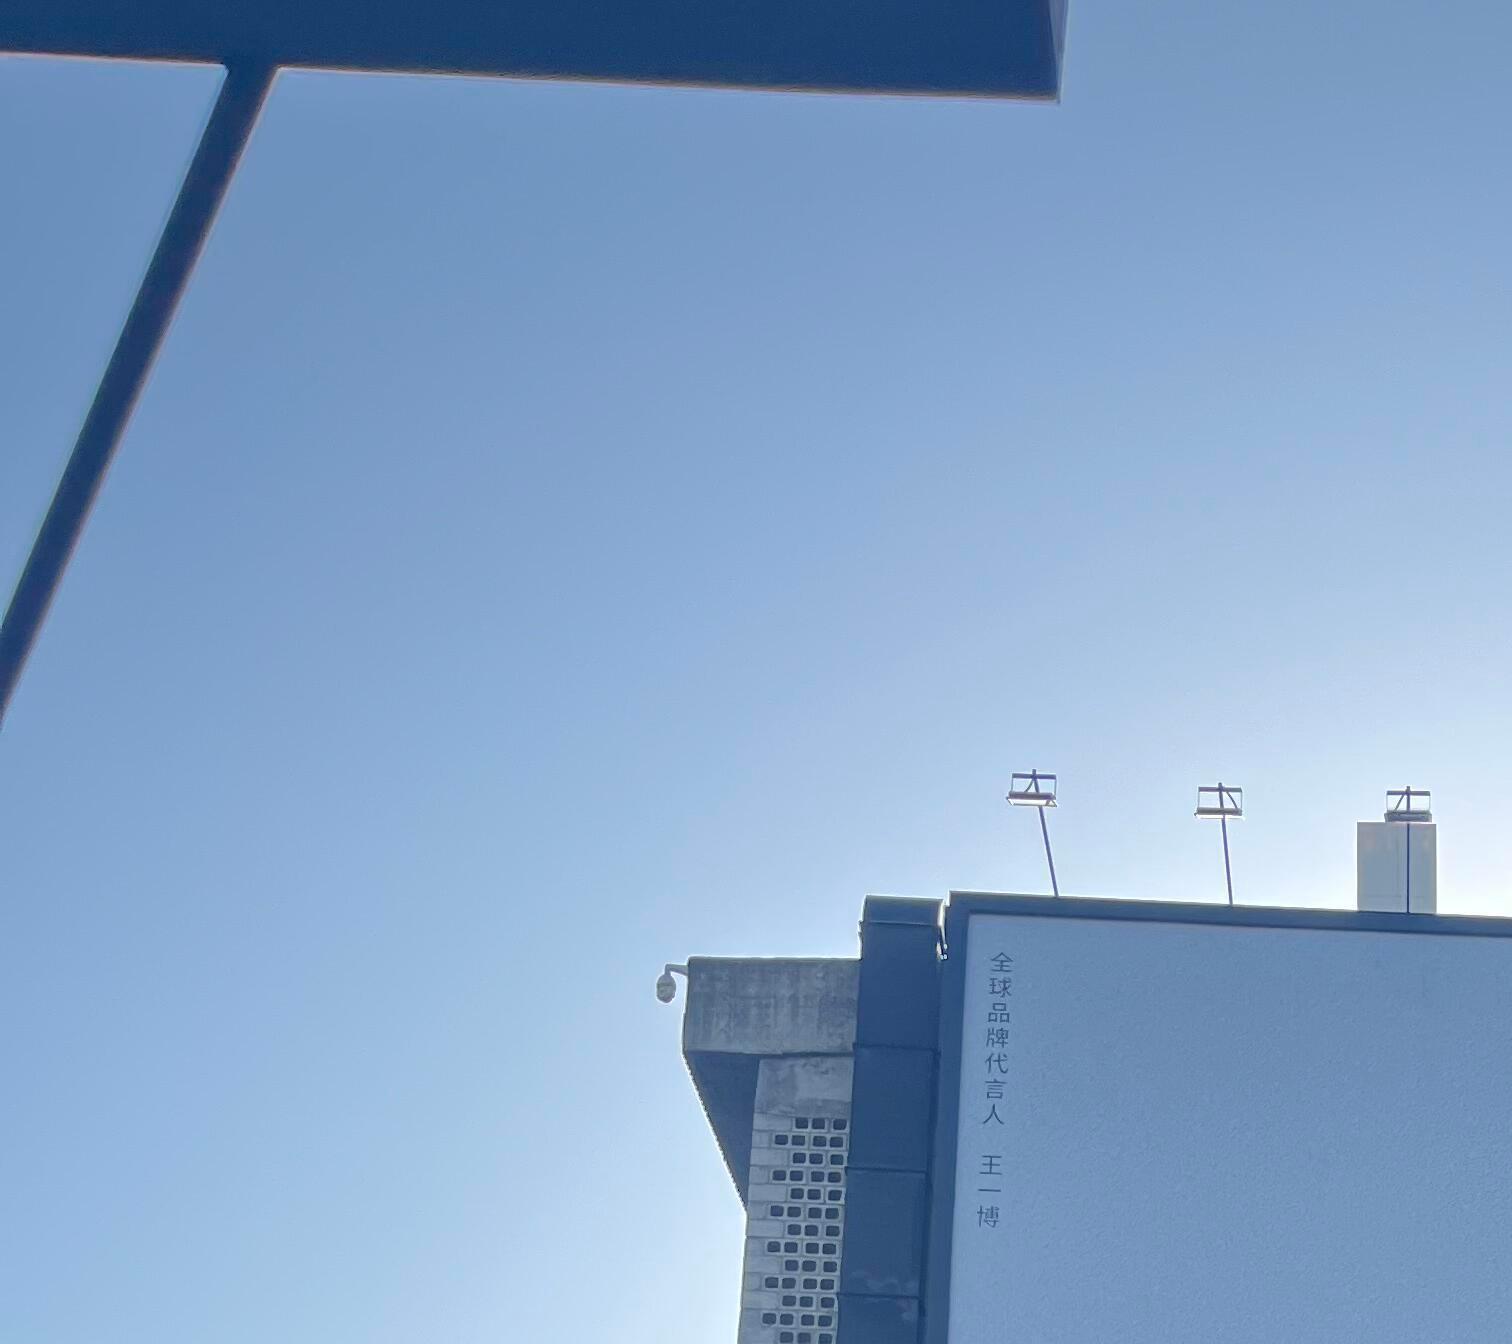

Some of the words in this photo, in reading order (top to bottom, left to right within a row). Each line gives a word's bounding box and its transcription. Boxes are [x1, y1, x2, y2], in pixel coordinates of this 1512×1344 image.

[982, 952, 1014, 1125] 全球品牌代言人
[976, 1154, 1003, 1228] 王一博
